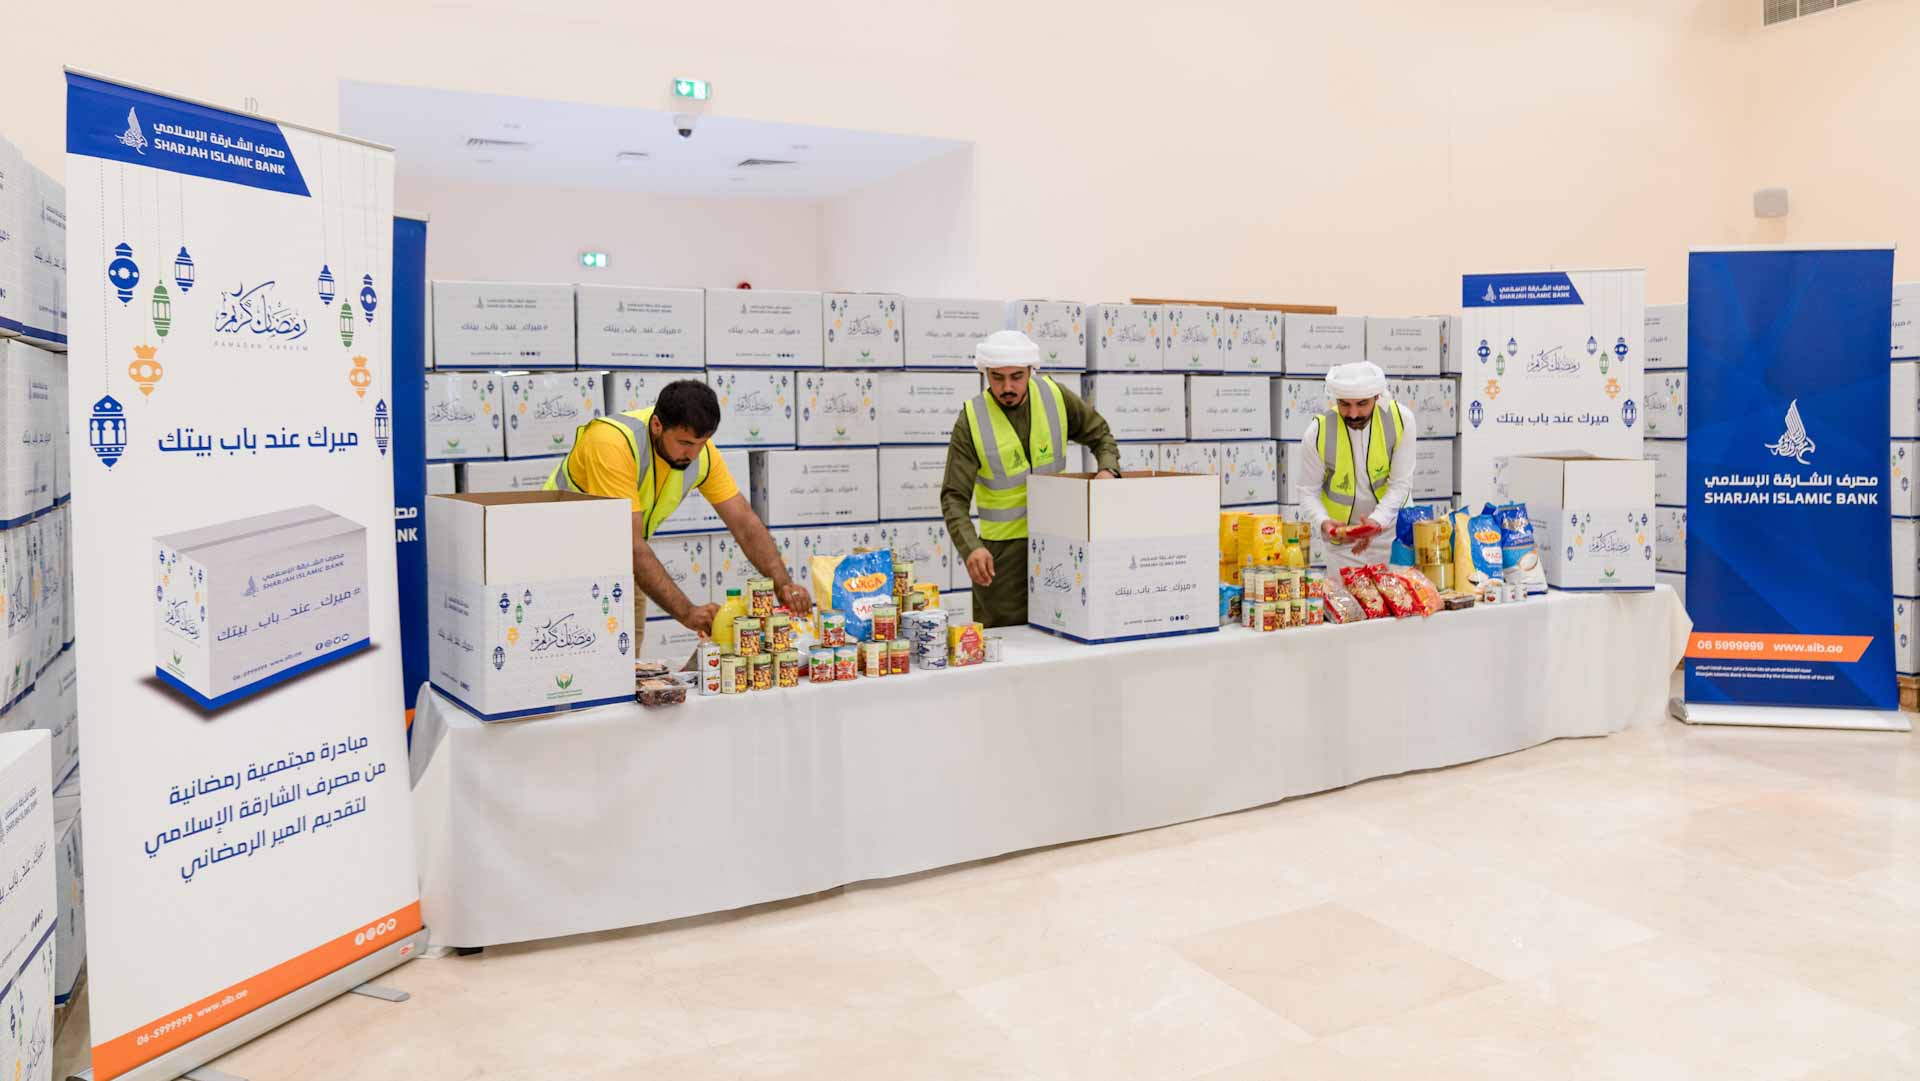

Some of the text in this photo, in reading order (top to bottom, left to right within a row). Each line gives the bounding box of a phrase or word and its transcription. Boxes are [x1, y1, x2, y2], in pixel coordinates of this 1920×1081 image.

[153, 123, 285, 158] مصرف الشارقة الإسلامي
[154, 138, 285, 175] SHARJAH ISLAMIC BANK
[1499, 292, 1527, 300] SHARJAH
[1496, 412, 1609, 426] ميرك عند باب بيتك
[158, 426, 358, 456] ميرك عند باب بيتك
[1704, 472, 1878, 489] مصرف الشارقة الإسلامي
[1704, 492, 1878, 505] SHARJAH ISLAMIC BANK
[1697, 640, 1712, 650] 06
[1773, 642, 1843, 653] www.sib.ae
[169, 736, 368, 805] مبادرة مجتمعية رمضانية
[144, 762, 386, 858] من مصرف الشارقة الإسلامي
[180, 796, 367, 883] لتقديم المير الرمضاني
[196, 989, 248, 1017] www.sib.ae
